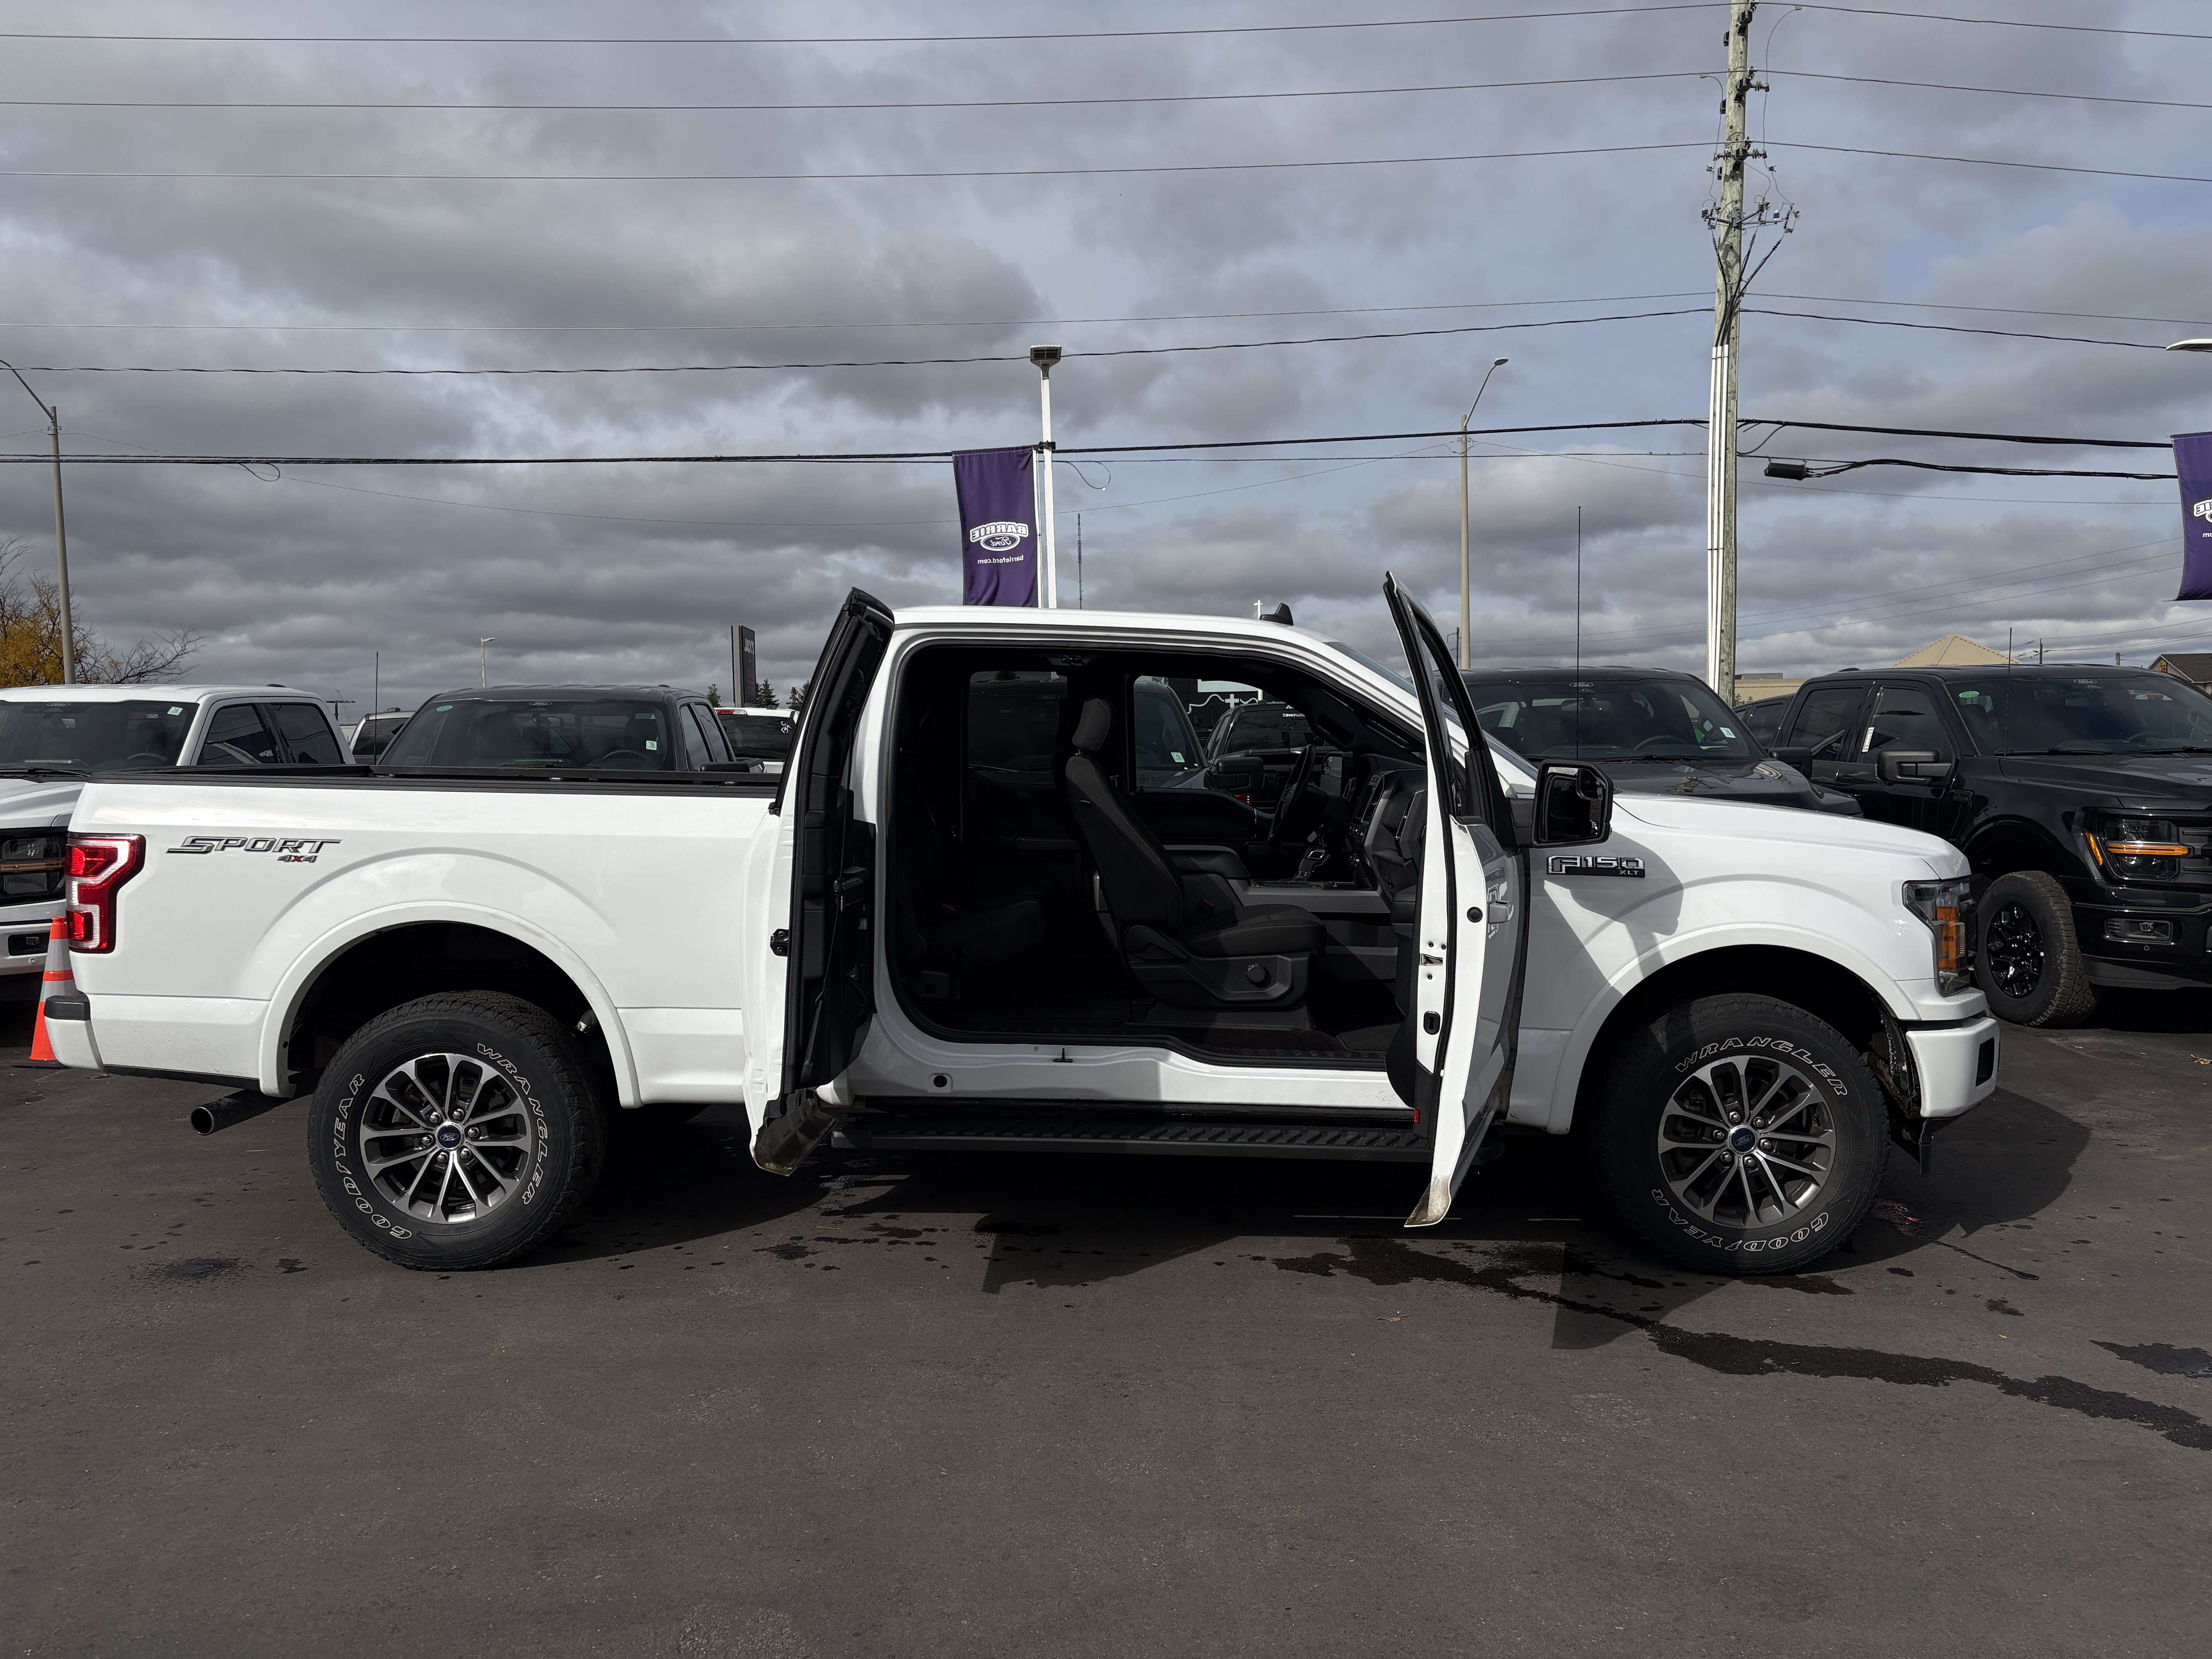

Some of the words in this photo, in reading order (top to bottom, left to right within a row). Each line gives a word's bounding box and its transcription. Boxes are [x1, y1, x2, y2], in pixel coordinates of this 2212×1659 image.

[166, 836, 342, 854] SPORT
[1675, 1036, 1848, 1096] WRANGLER
[477, 1043, 548, 1204] WRANGLER
